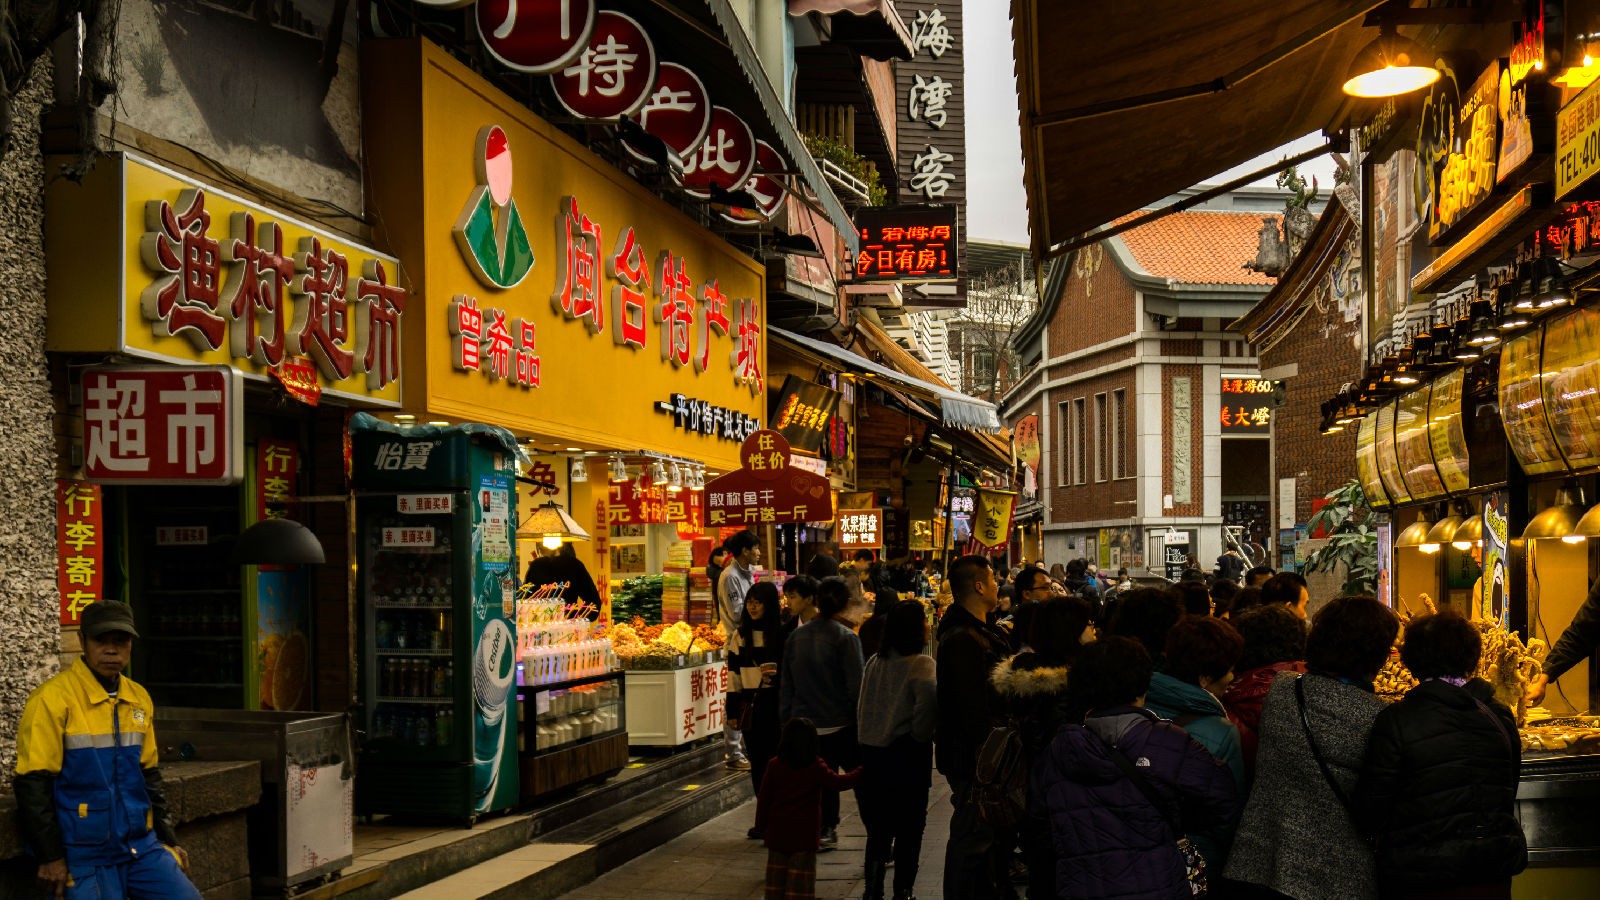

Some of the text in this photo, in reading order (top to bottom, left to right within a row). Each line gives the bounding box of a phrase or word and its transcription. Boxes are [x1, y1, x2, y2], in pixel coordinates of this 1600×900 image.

[909, 9, 955, 199] 海湾客
[152, 187, 406, 391] 渔村超市
[558, 195, 763, 395] 闽台特产城
[86, 374, 222, 474] 超市
[758, 434, 774, 450] 任
[749, 451, 785, 470] 性价
[709, 489, 775, 506] 散称鱼干
[710, 505, 808, 524] 买一斤送一斤
